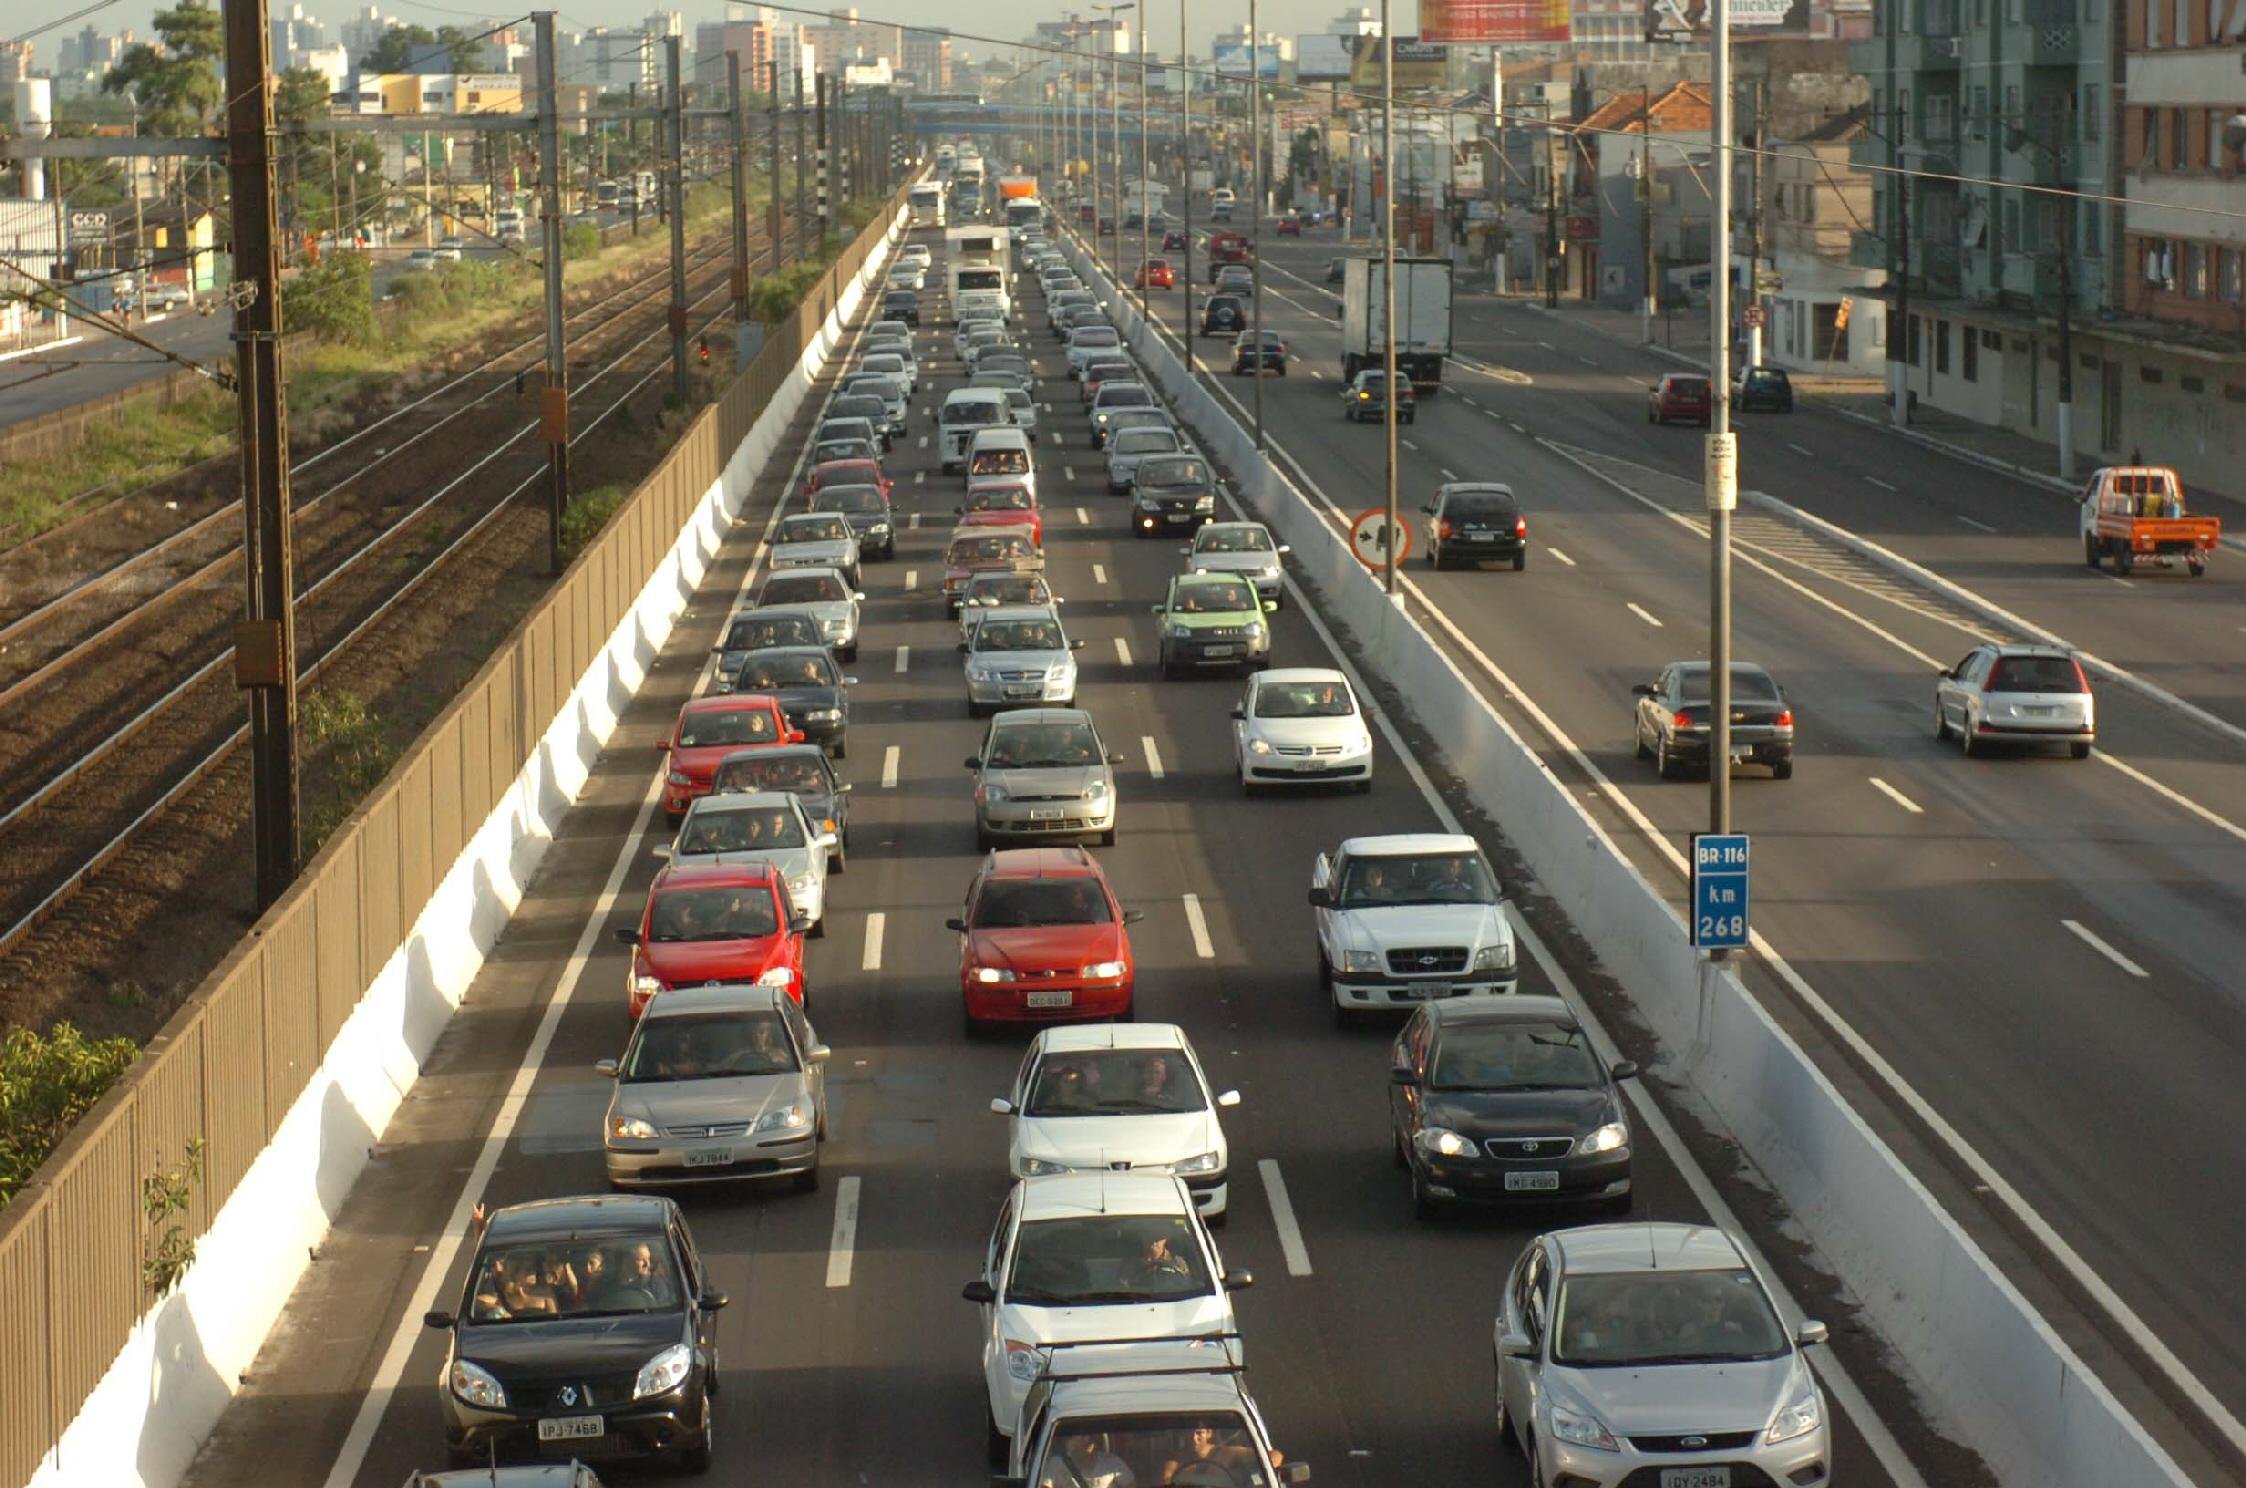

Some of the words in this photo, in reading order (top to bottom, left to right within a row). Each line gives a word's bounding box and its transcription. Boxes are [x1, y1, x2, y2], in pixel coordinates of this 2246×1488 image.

[1699, 847, 1745, 864] BR-116
[1709, 885, 1736, 903] km
[1700, 915, 1743, 938] 268
